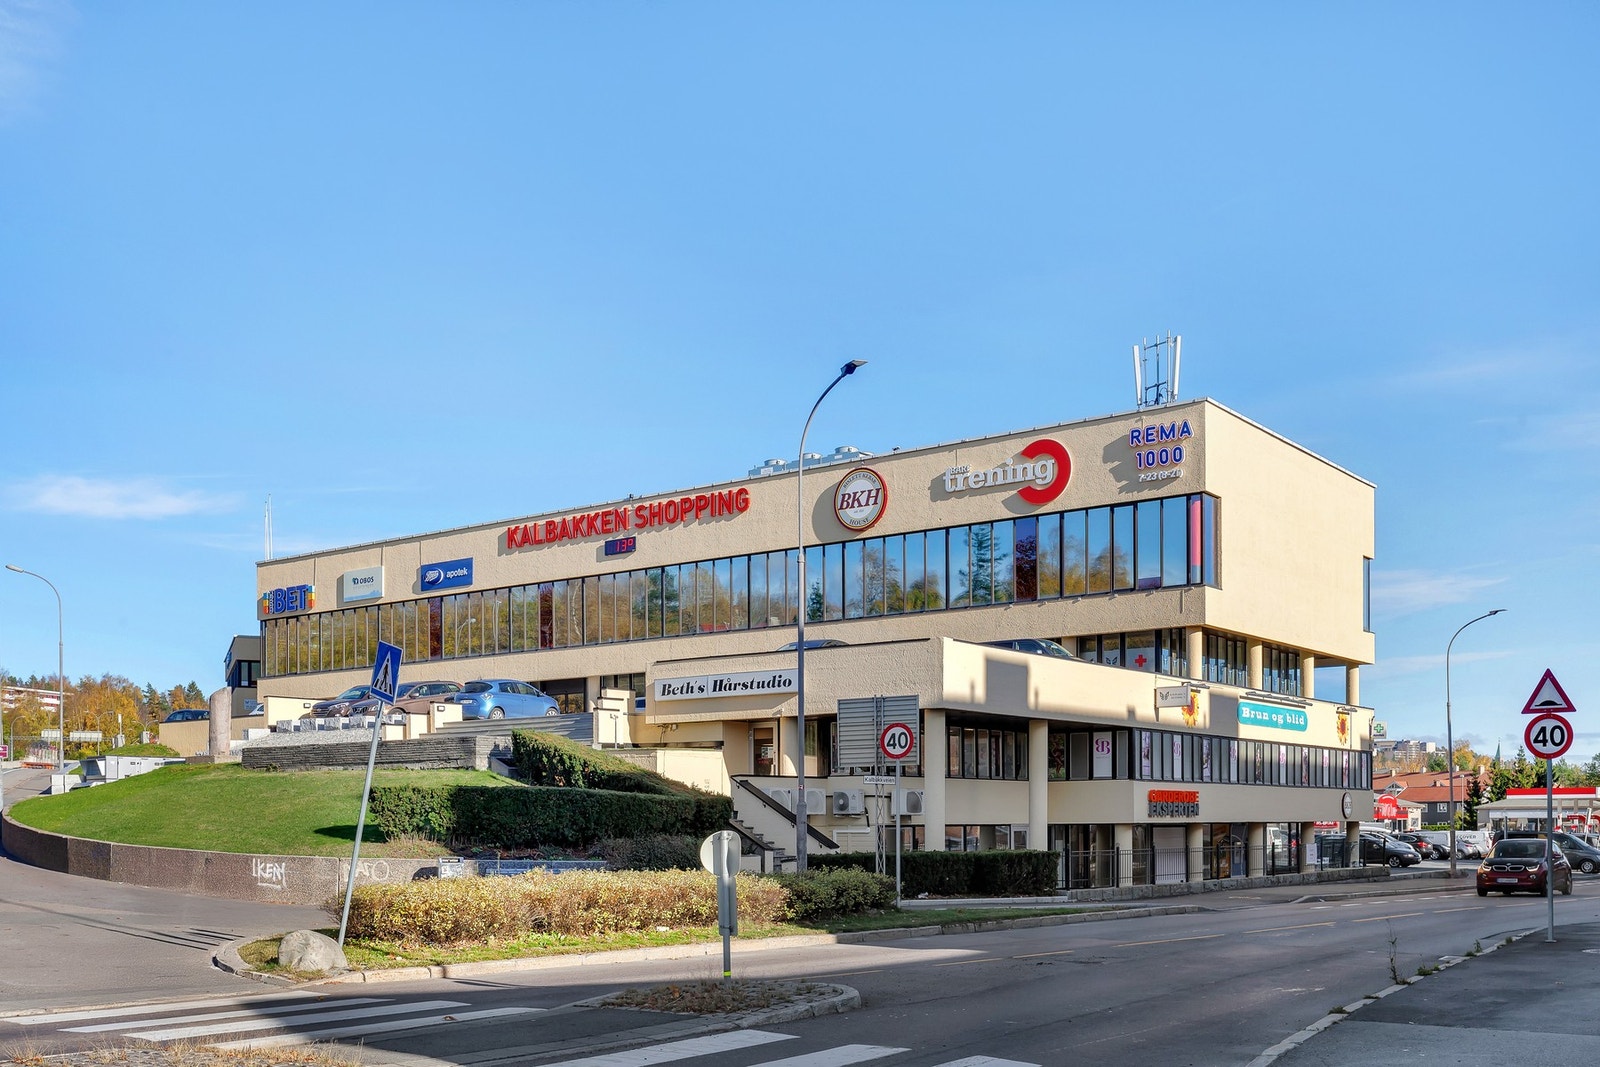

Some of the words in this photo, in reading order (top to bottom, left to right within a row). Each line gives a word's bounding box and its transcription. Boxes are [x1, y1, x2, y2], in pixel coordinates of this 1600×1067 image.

[1129, 420, 1193, 446] REMA
[1136, 445, 1185, 469] 1000
[943, 457, 1055, 493] trening
[838, 488, 882, 510] BKH
[507, 507, 630, 549] KALBAKKEN
[635, 488, 751, 529] SHOPPING
[359, 576, 374, 584] OBOS
[446, 567, 468, 579] apotek
[274, 584, 309, 613] BET
[711, 675, 793, 692] Hårstudio
[1242, 706, 1269, 720] Brun
[1272, 712, 1284, 724] og
[1286, 711, 1305, 725] blid
[886, 732, 909, 749] 40
[1533, 725, 1565, 747] 40
[1148, 789, 1199, 802] GARDEROBE
[1149, 802, 1199, 816] EKSPERTEN
